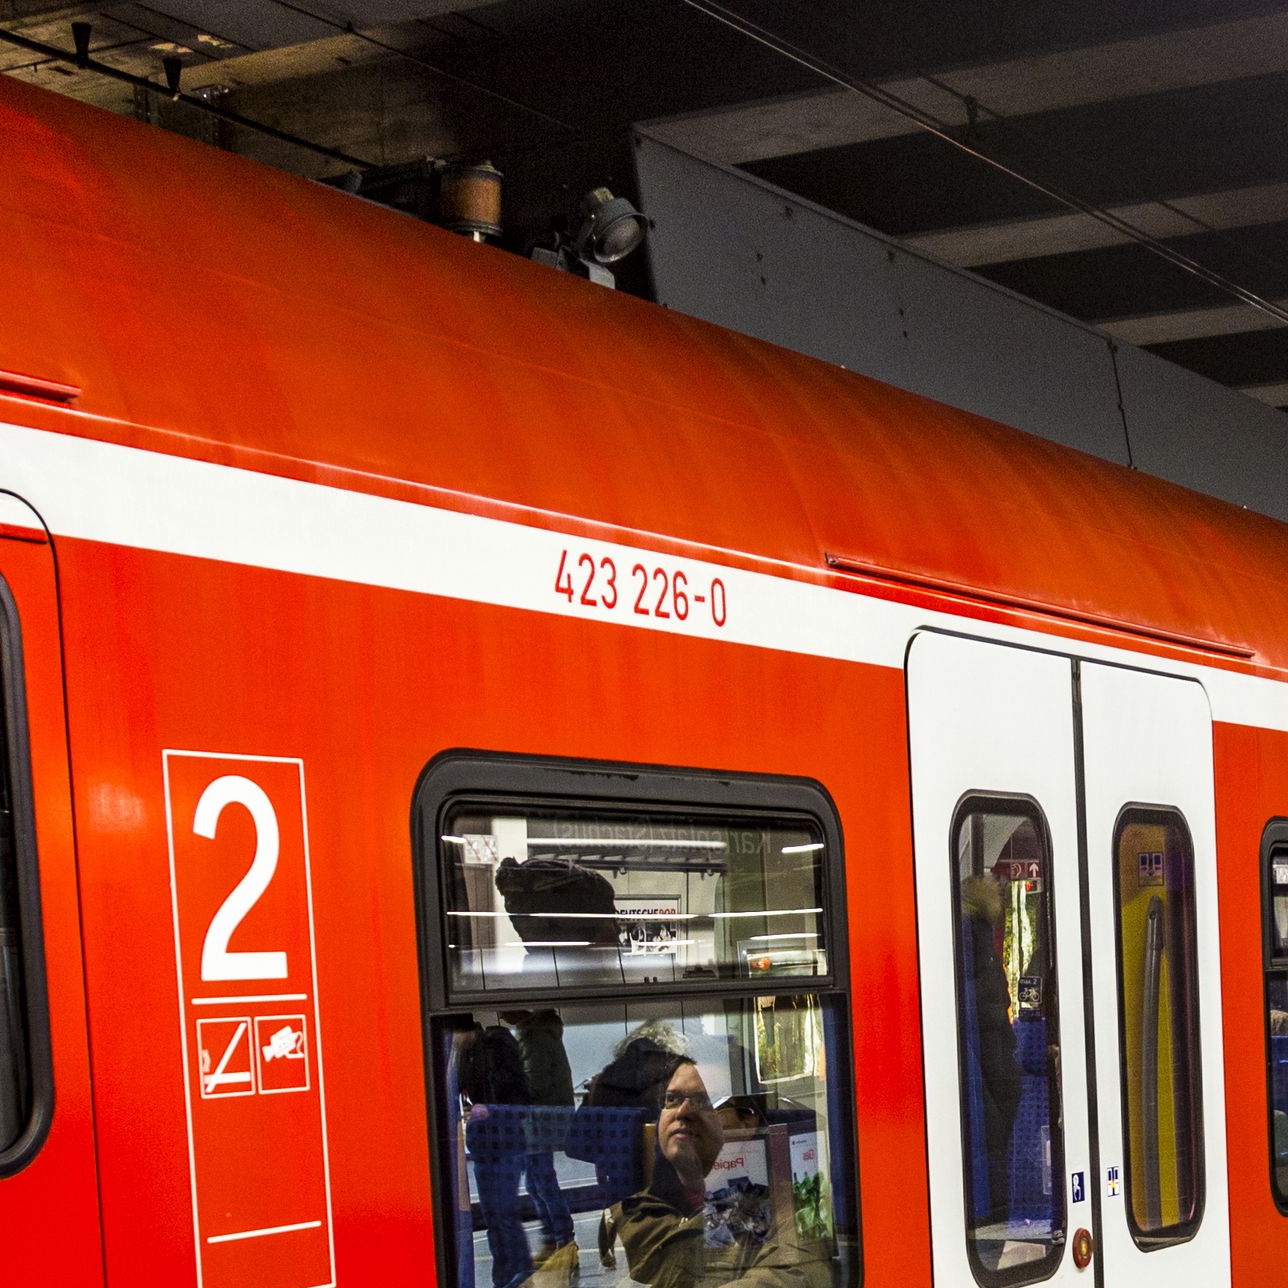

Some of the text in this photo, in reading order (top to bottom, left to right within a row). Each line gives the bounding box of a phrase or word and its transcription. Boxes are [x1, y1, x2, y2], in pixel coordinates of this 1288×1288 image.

[554, 549, 727, 628] 423 226-0
[192, 774, 289, 982] 2
